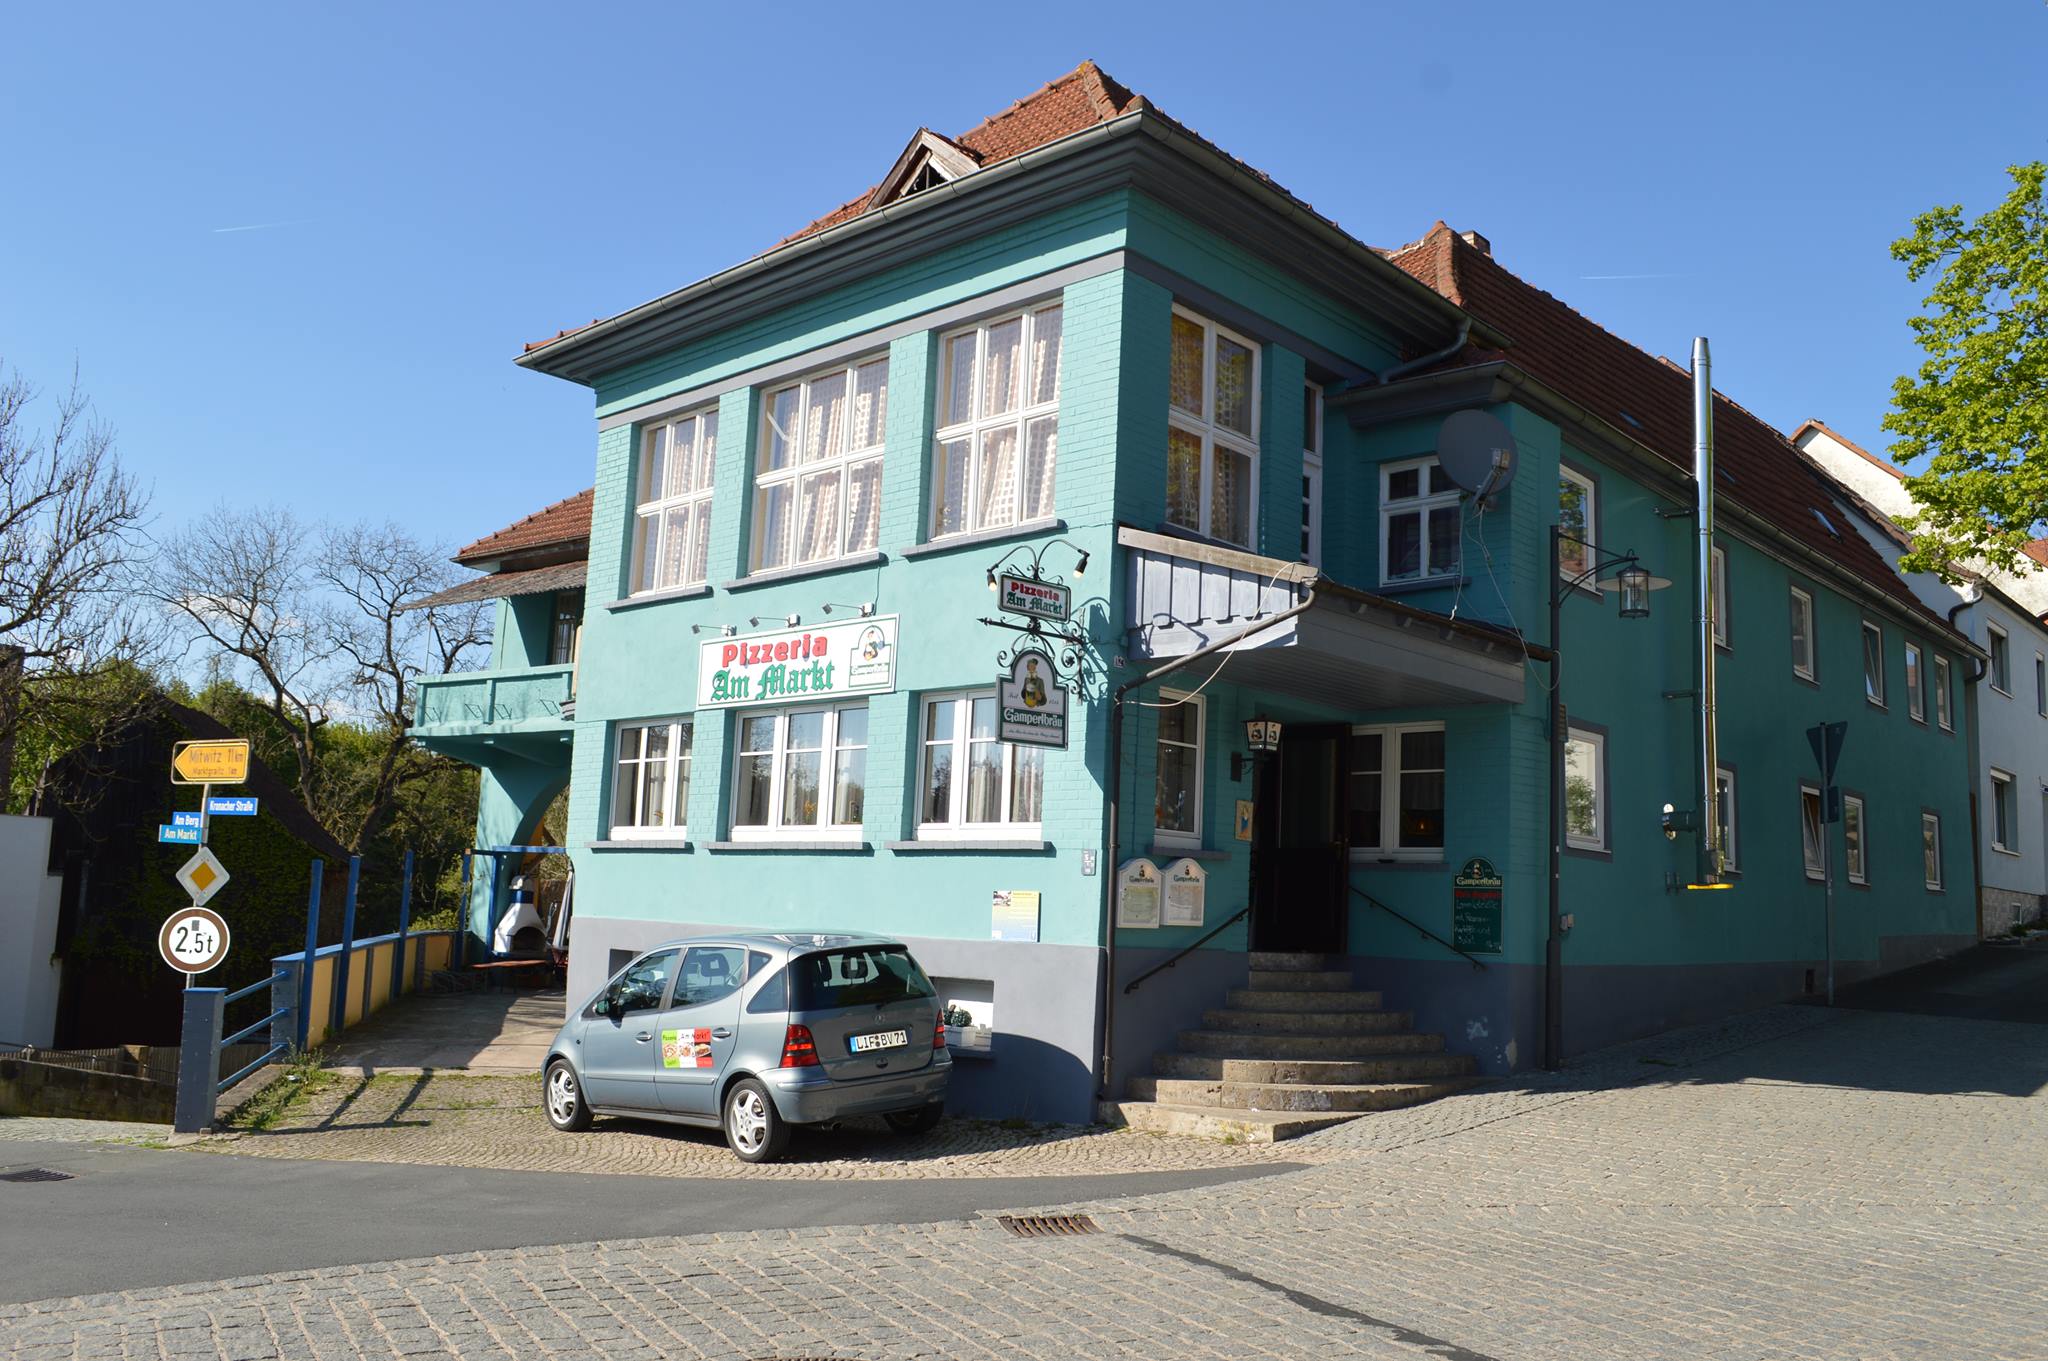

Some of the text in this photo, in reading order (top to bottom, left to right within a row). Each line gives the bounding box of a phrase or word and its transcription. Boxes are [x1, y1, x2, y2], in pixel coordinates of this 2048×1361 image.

[1010, 582, 1060, 602] Pizzeria
[1006, 594, 1064, 616] Am Markt
[722, 634, 828, 667] Pizzeria
[711, 660, 835, 701] Am Markt
[189, 748, 223, 765] Mitwitz
[209, 800, 254, 812] Kronacher Straße
[174, 815, 200, 828] Am Berg
[164, 828, 197, 840] Am Markt
[856, 1031, 907, 1049] LIF BV 71
